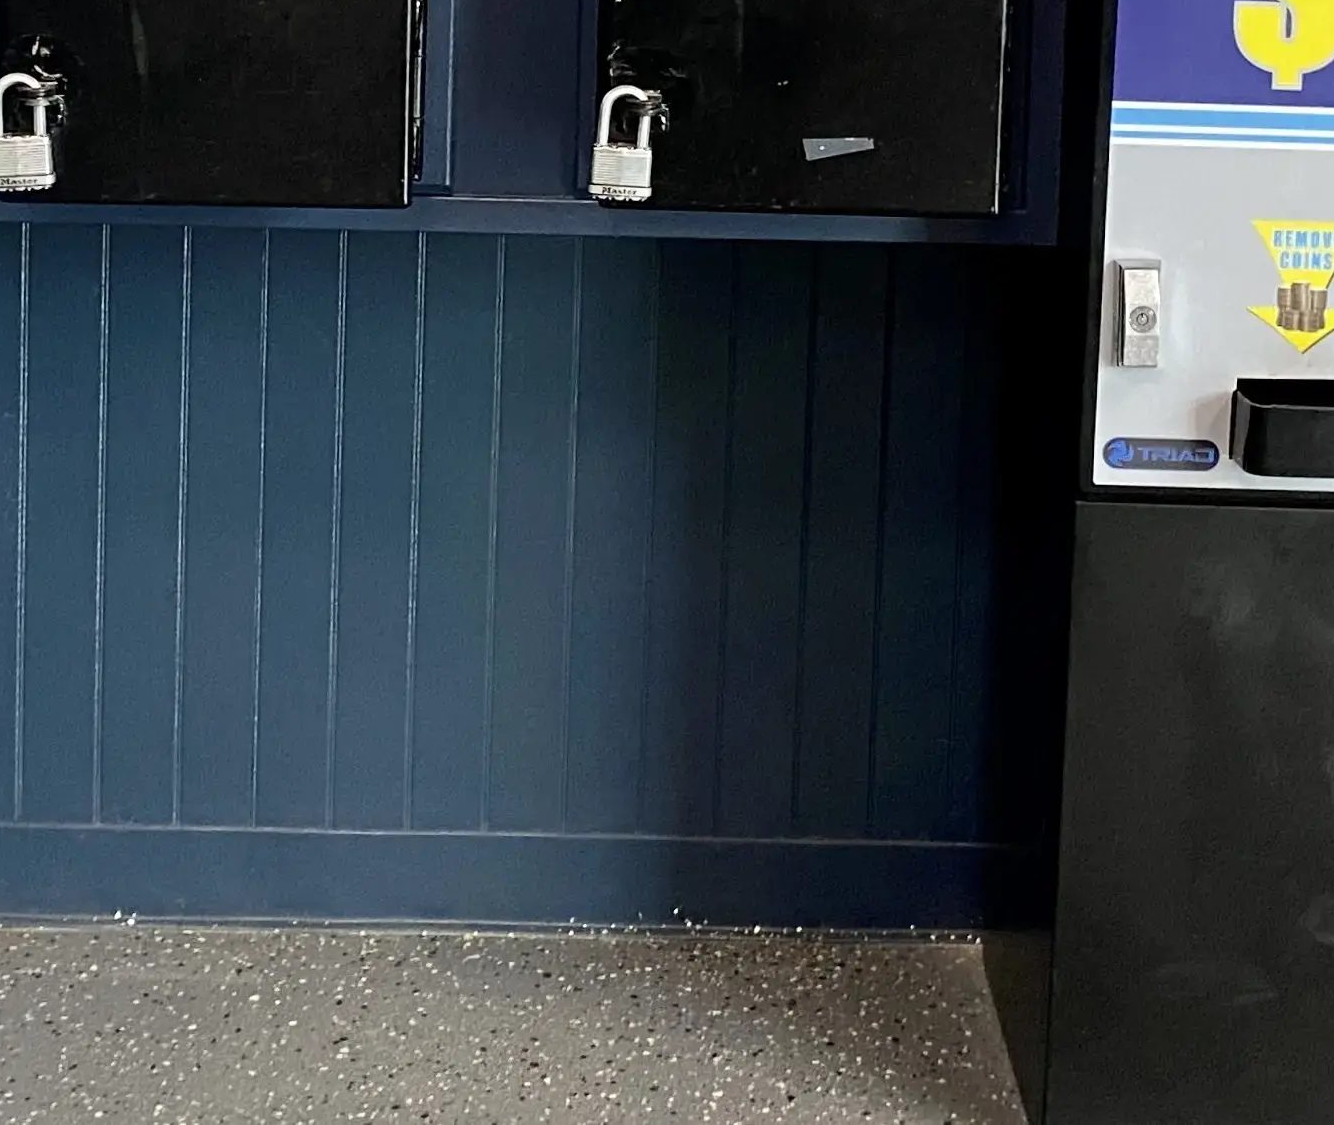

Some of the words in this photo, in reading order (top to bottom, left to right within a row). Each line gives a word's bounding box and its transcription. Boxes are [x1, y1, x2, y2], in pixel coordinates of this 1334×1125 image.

[0, 178, 38, 186] Master
[602, 186, 637, 195] Master
[1279, 252, 1333, 271] COINS
[1137, 446, 1215, 463] TRIAD
